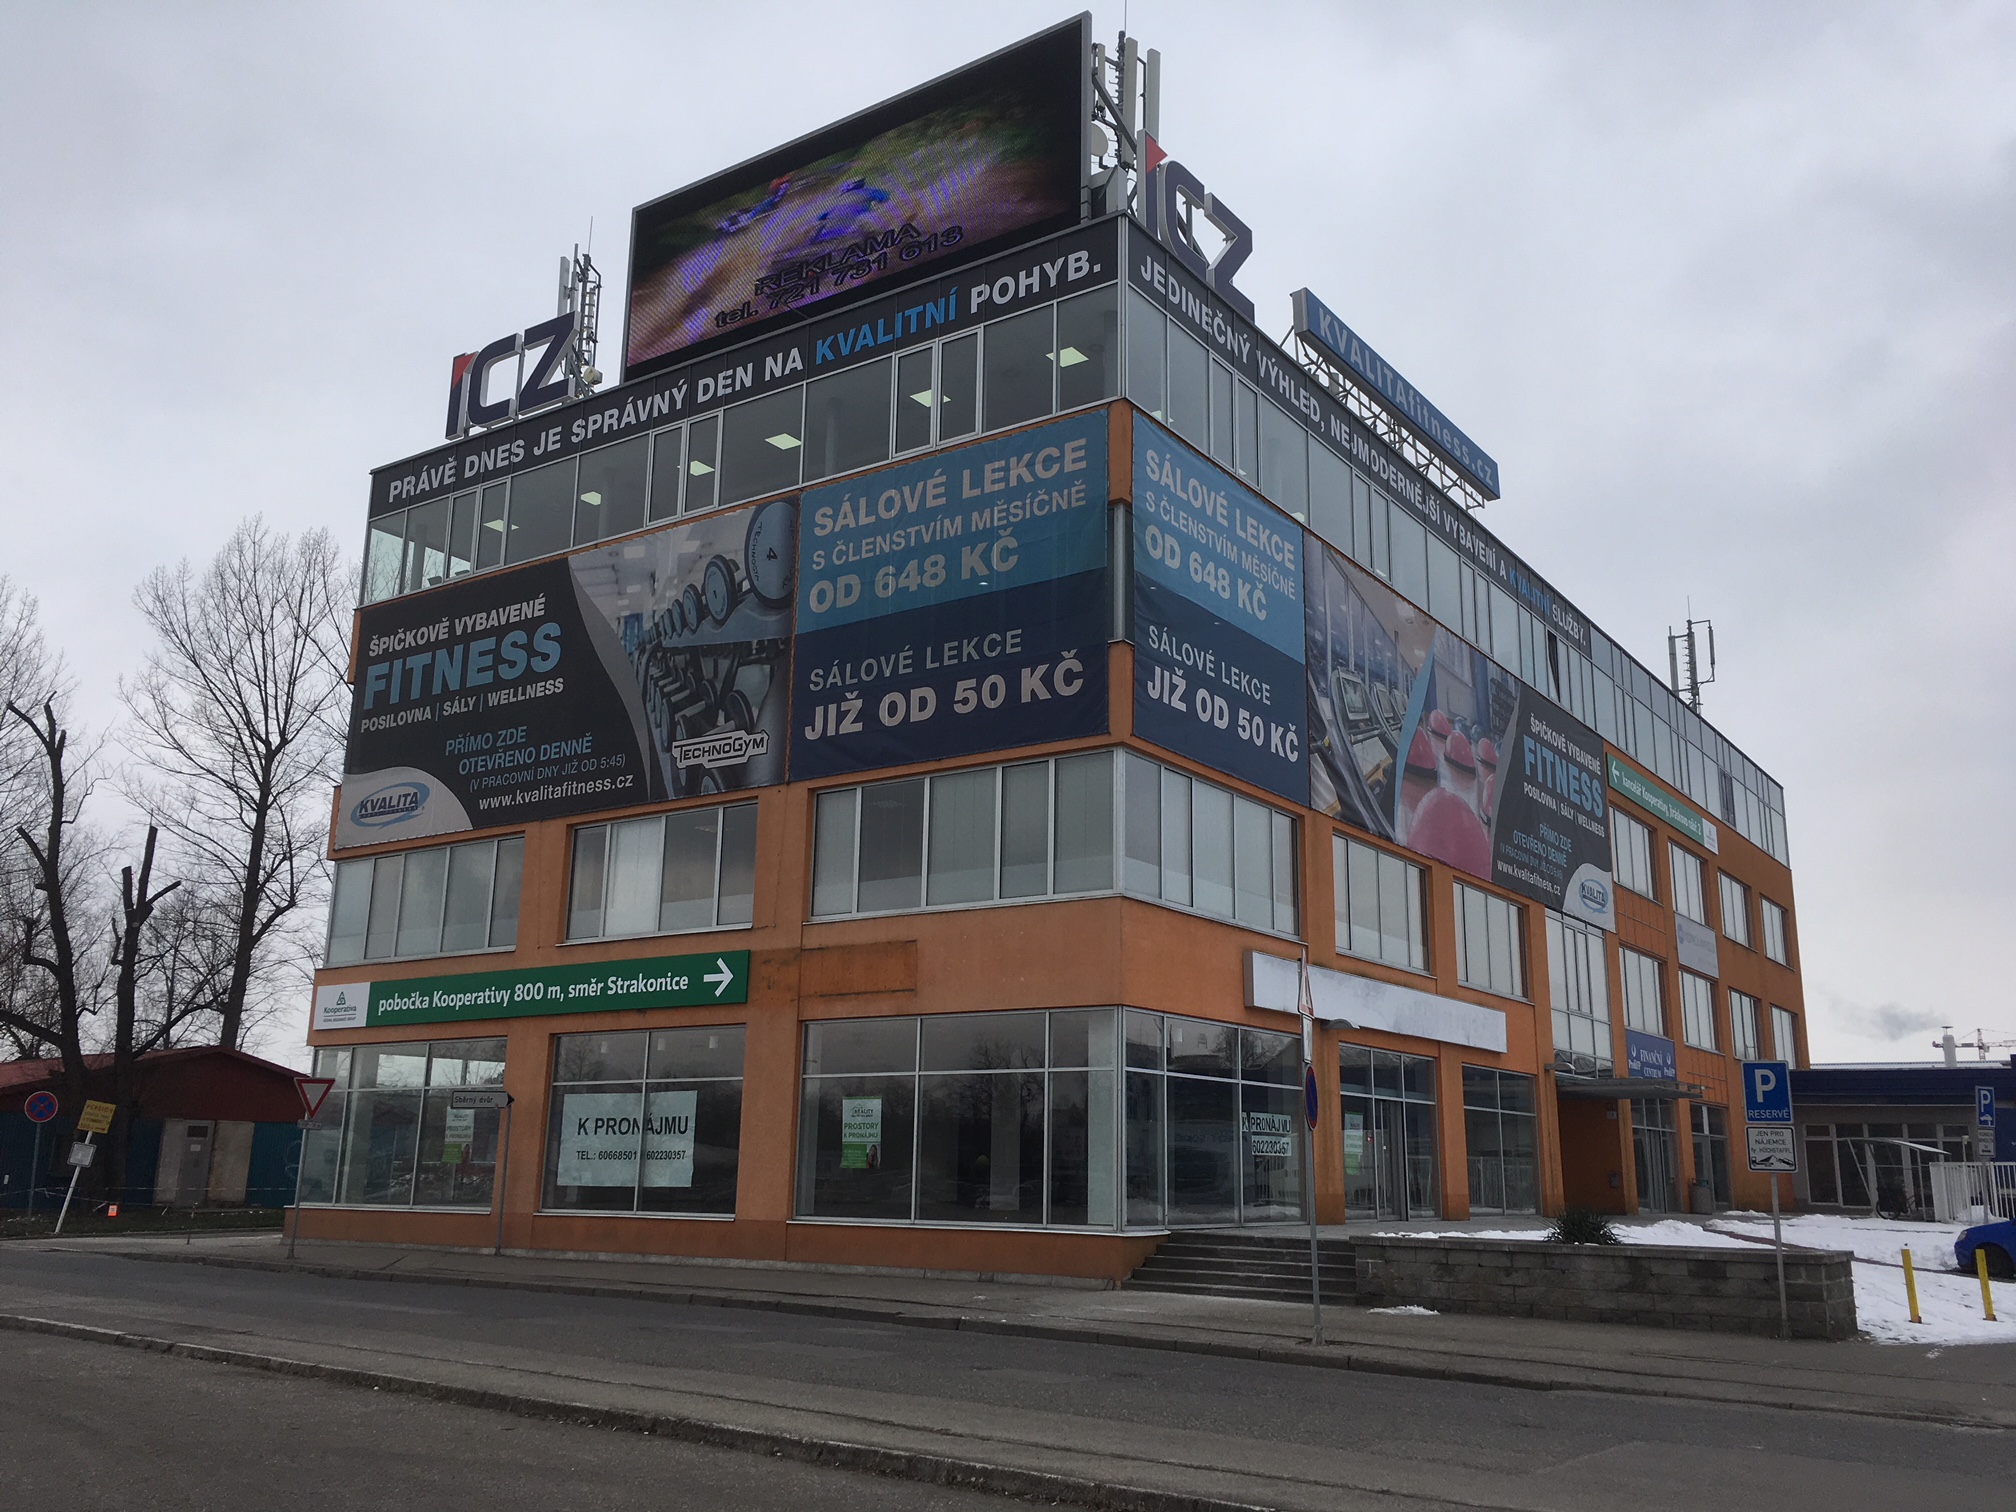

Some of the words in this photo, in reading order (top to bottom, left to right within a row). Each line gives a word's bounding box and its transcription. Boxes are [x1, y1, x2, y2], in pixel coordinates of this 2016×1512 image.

[1137, 128, 1256, 325] ICZ
[715, 302, 758, 328] tel.
[766, 276, 820, 308] 721
[831, 250, 888, 286] 731
[900, 225, 964, 262] 613
[754, 222, 922, 297] REKLAMA
[388, 455, 457, 503] PRÁVĚ
[464, 440, 525, 482] DNES
[533, 425, 562, 457] JE
[571, 378, 688, 444] SPRÁVNÝ
[697, 363, 753, 403] DEN
[764, 347, 803, 381] NA
[815, 286, 958, 365] KVALITNÍ
[970, 250, 1101, 314] POHYB.
[446, 310, 580, 440] ICZ
[1319, 307, 1494, 487] KVALITAfitness.cz
[1140, 255, 1250, 364] JEDINEČNÝ
[1256, 349, 1325, 432] VÝHLED,
[1330, 412, 1440, 526] NEJMODERNĚJŠÍ
[1443, 510, 1496, 571] VYBAVENÍ
[1500, 560, 1507, 580] A
[1509, 566, 1550, 616] KVALITNÍ
[1552, 604, 1586, 646] SLUŽBY.
[813, 468, 947, 538] SÁLOVÉ
[961, 437, 1088, 500] LEKCE
[1145, 449, 1229, 528] SÁLOVÉ
[1235, 508, 1296, 572] LEKCE
[812, 549, 826, 571] S
[831, 511, 962, 566] ČLENSTVÍM
[970, 479, 1087, 533] MĚSÍČNĚ
[1146, 490, 1156, 513] S
[1159, 496, 1238, 564] ČLENSTVÍM
[1241, 549, 1296, 601] MĚSÍČNĚ
[808, 574, 861, 614] OD
[874, 554, 946, 599] 648
[961, 527, 1019, 580] KČ
[1145, 524, 1181, 570] OD
[1189, 550, 1231, 600] 648
[1237, 576, 1268, 621] KČ
[368, 616, 450, 657] ŠPIČKOVĚ
[454, 592, 546, 637] VYBAVENÉ
[363, 622, 562, 710] FITNESS
[809, 644, 914, 692] SÁLOVÉ
[926, 628, 1023, 668] LEKCE
[1148, 624, 1216, 678] SÁLOVÉ
[1222, 661, 1271, 706] LEKCE
[360, 705, 432, 733] POSILOVNA
[442, 695, 476, 716] SÁLY
[487, 677, 564, 708] WELLNESS
[804, 690, 864, 741] JIŽ
[878, 686, 937, 727] OD
[953, 674, 1006, 715] 50
[1021, 649, 1085, 704] KČ
[1146, 665, 1187, 712] JIŽ
[1195, 687, 1230, 730] OD
[1237, 710, 1265, 748] 50
[1270, 720, 1299, 763] KČ
[445, 732, 493, 757] PŘÍMO
[496, 726, 527, 747] ZDE
[458, 747, 536, 776] OTEVŘENO
[539, 732, 593, 761] DENNĚ
[482, 768, 535, 788] PRACOVNÍ
[536, 765, 558, 781] DNY
[561, 758, 578, 776] JIŽ
[581, 757, 597, 772] OD
[599, 753, 626, 769] 5:45)
[1530, 712, 1566, 753] ŠPIČKOVĚ
[1567, 740, 1601, 776] VYBAVENÉ
[359, 791, 418, 814] KVALITA
[478, 774, 634, 811] www.kvalitafitness.cz
[1523, 734, 1603, 818] FITNESS
[1523, 781, 1557, 812] POSILOVNA
[1560, 802, 1574, 821] SÁLY
[1577, 813, 1605, 838] WELLNESS
[1513, 829, 1547, 857] OTEVŘENO
[1560, 834, 1572, 853] ZDE
[1497, 859, 1561, 896] www.kvalitafitness.cz
[323, 1005, 357, 1014] Kooperativa
[378, 991, 429, 1016] pobočka
[432, 986, 511, 1010] Kooperativy
[514, 982, 544, 1002] 800
[547, 985, 565, 1002] m,
[568, 977, 604, 998] směr
[607, 972, 689, 995] Strakonice
[1754, 1068, 1777, 1103] P
[1980, 1090, 1991, 1113] P
[577, 1117, 590, 1136] K
[594, 1113, 689, 1136] PRONÁJMU
[646, 1150, 686, 1161] 602230357
[844, 1122, 879, 1130] PROSTORY
[1242, 1116, 1249, 1131] K
